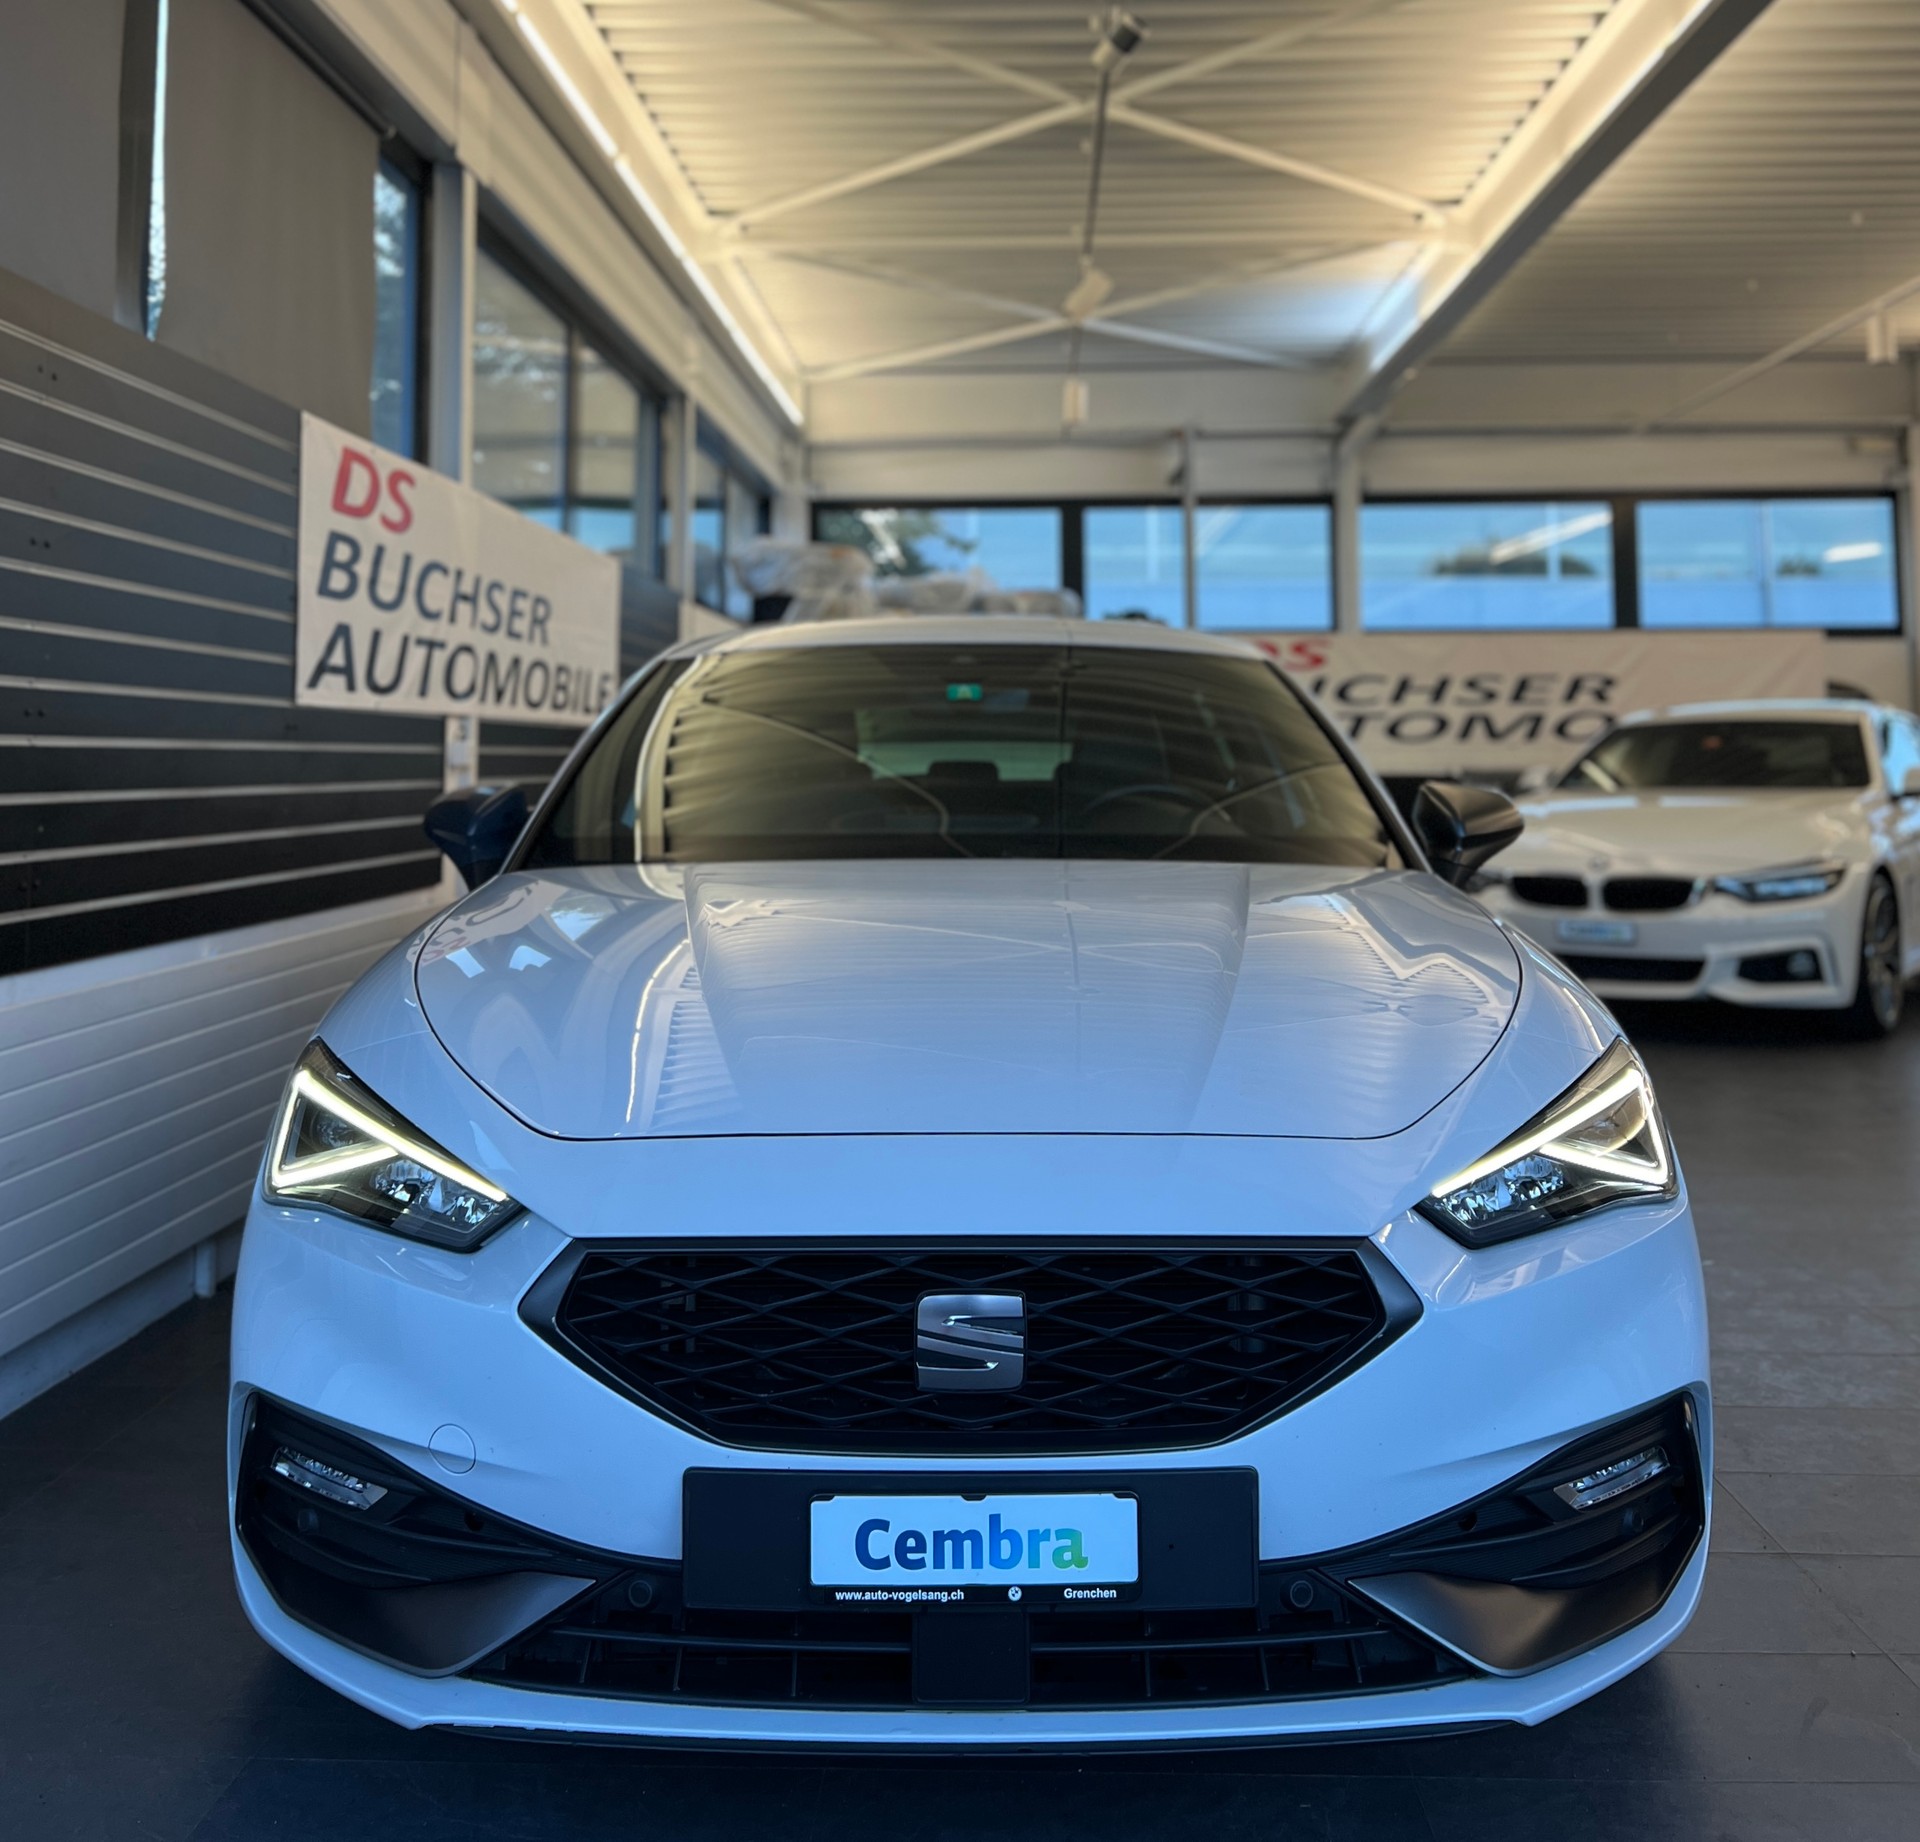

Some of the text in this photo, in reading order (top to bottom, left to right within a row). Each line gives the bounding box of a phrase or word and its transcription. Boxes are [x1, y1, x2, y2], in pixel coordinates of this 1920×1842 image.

[331, 445, 416, 534] DS
[316, 529, 553, 647] BUCHSER
[854, 1513, 1089, 1571] Cembra
[835, 1587, 1117, 1603] www.auto-vogelsang.ch Grenchen
